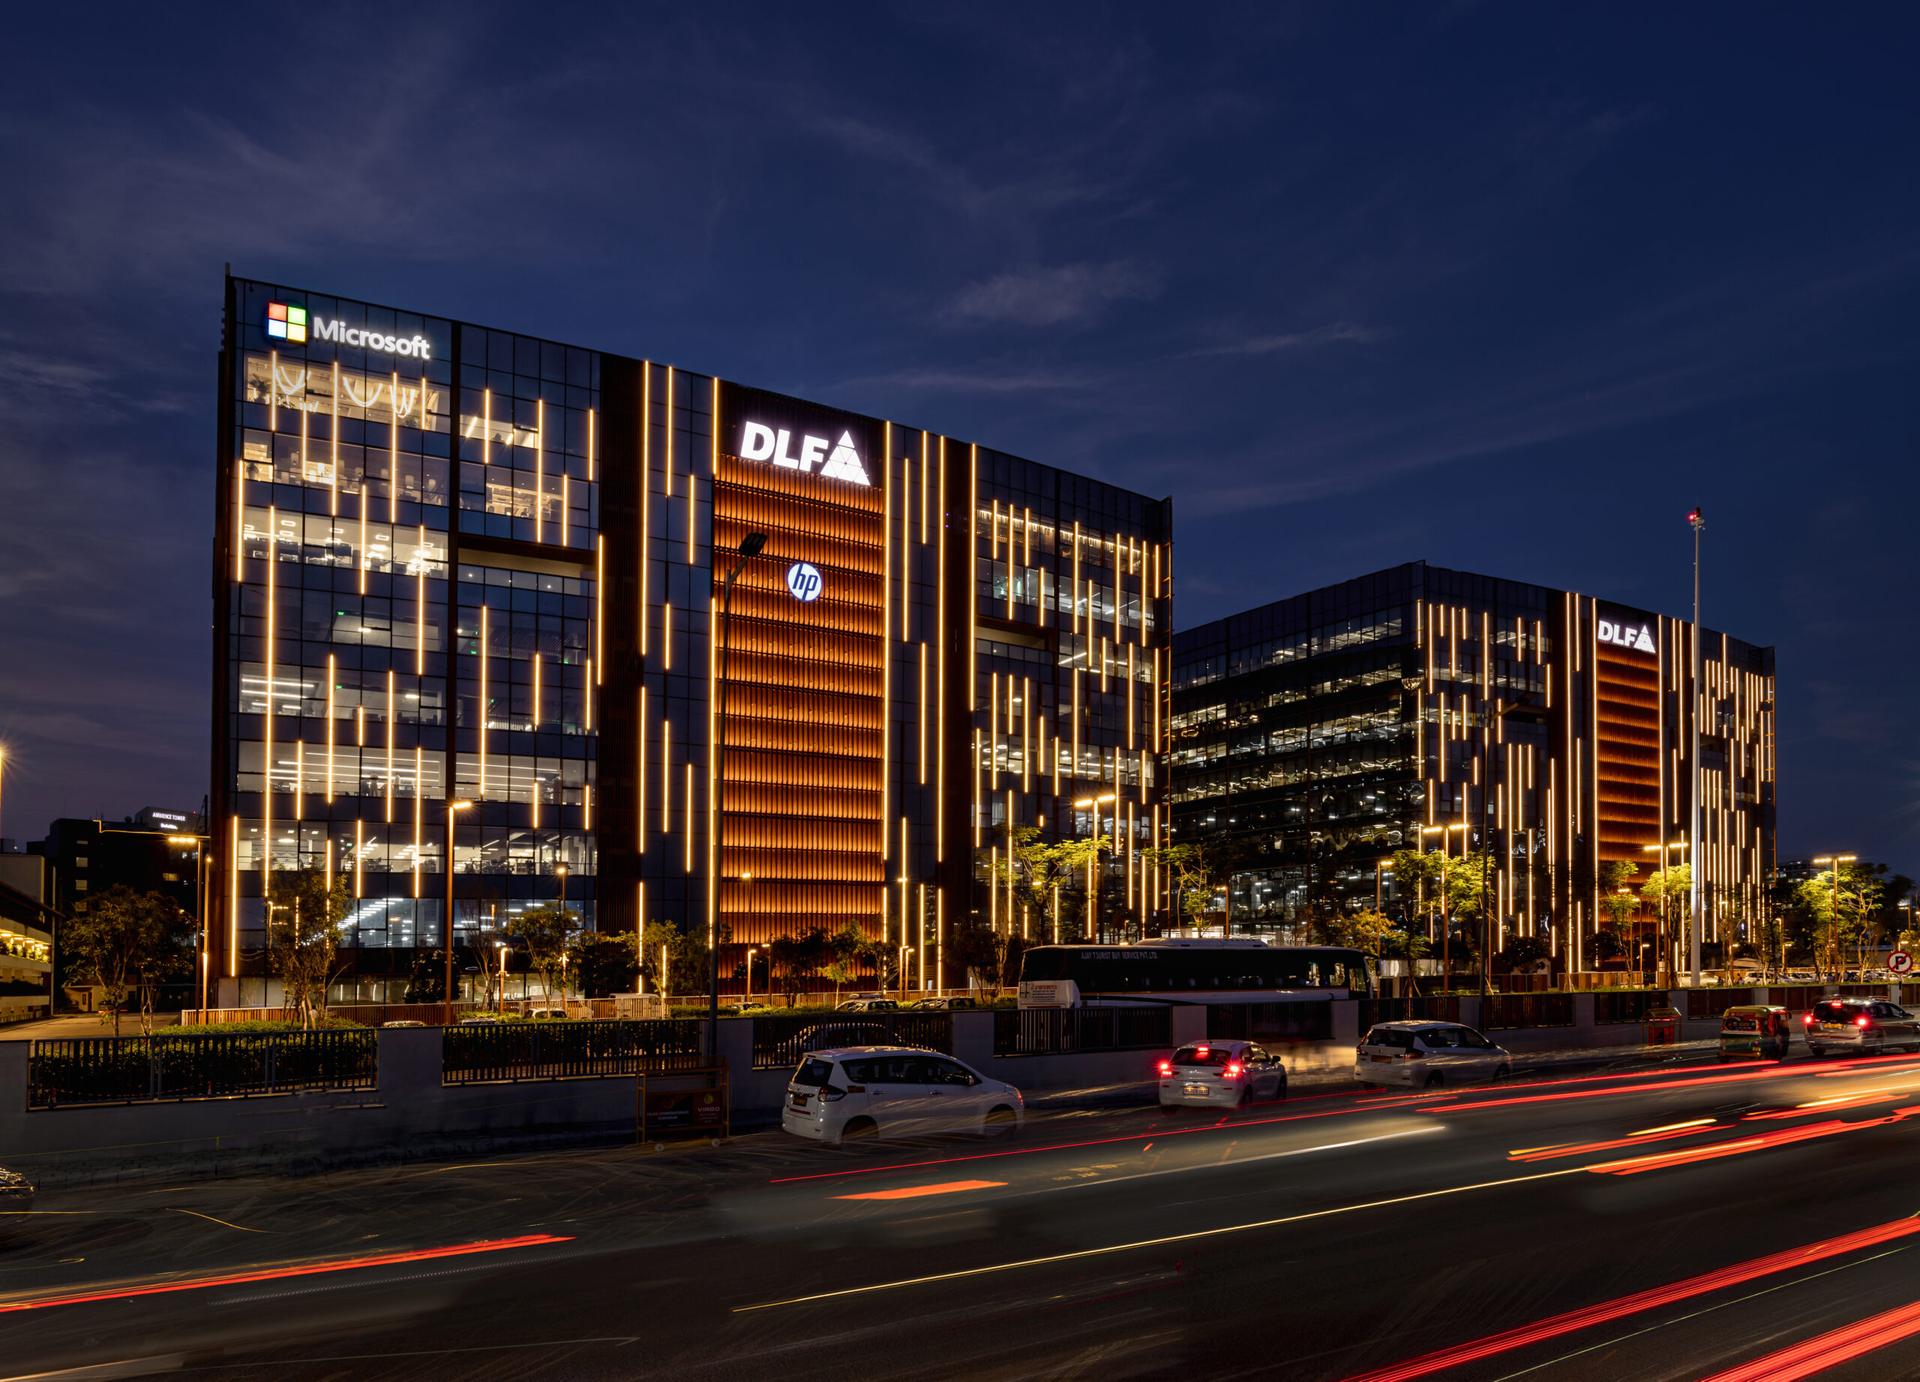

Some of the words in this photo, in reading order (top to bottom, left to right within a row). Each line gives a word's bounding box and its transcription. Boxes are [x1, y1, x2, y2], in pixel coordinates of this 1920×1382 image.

[312, 316, 431, 360] Microsoft
[740, 421, 829, 472] DLF
[792, 563, 819, 601] hp
[1597, 619, 1638, 647] DLF
[1895, 956, 1907, 970] P
